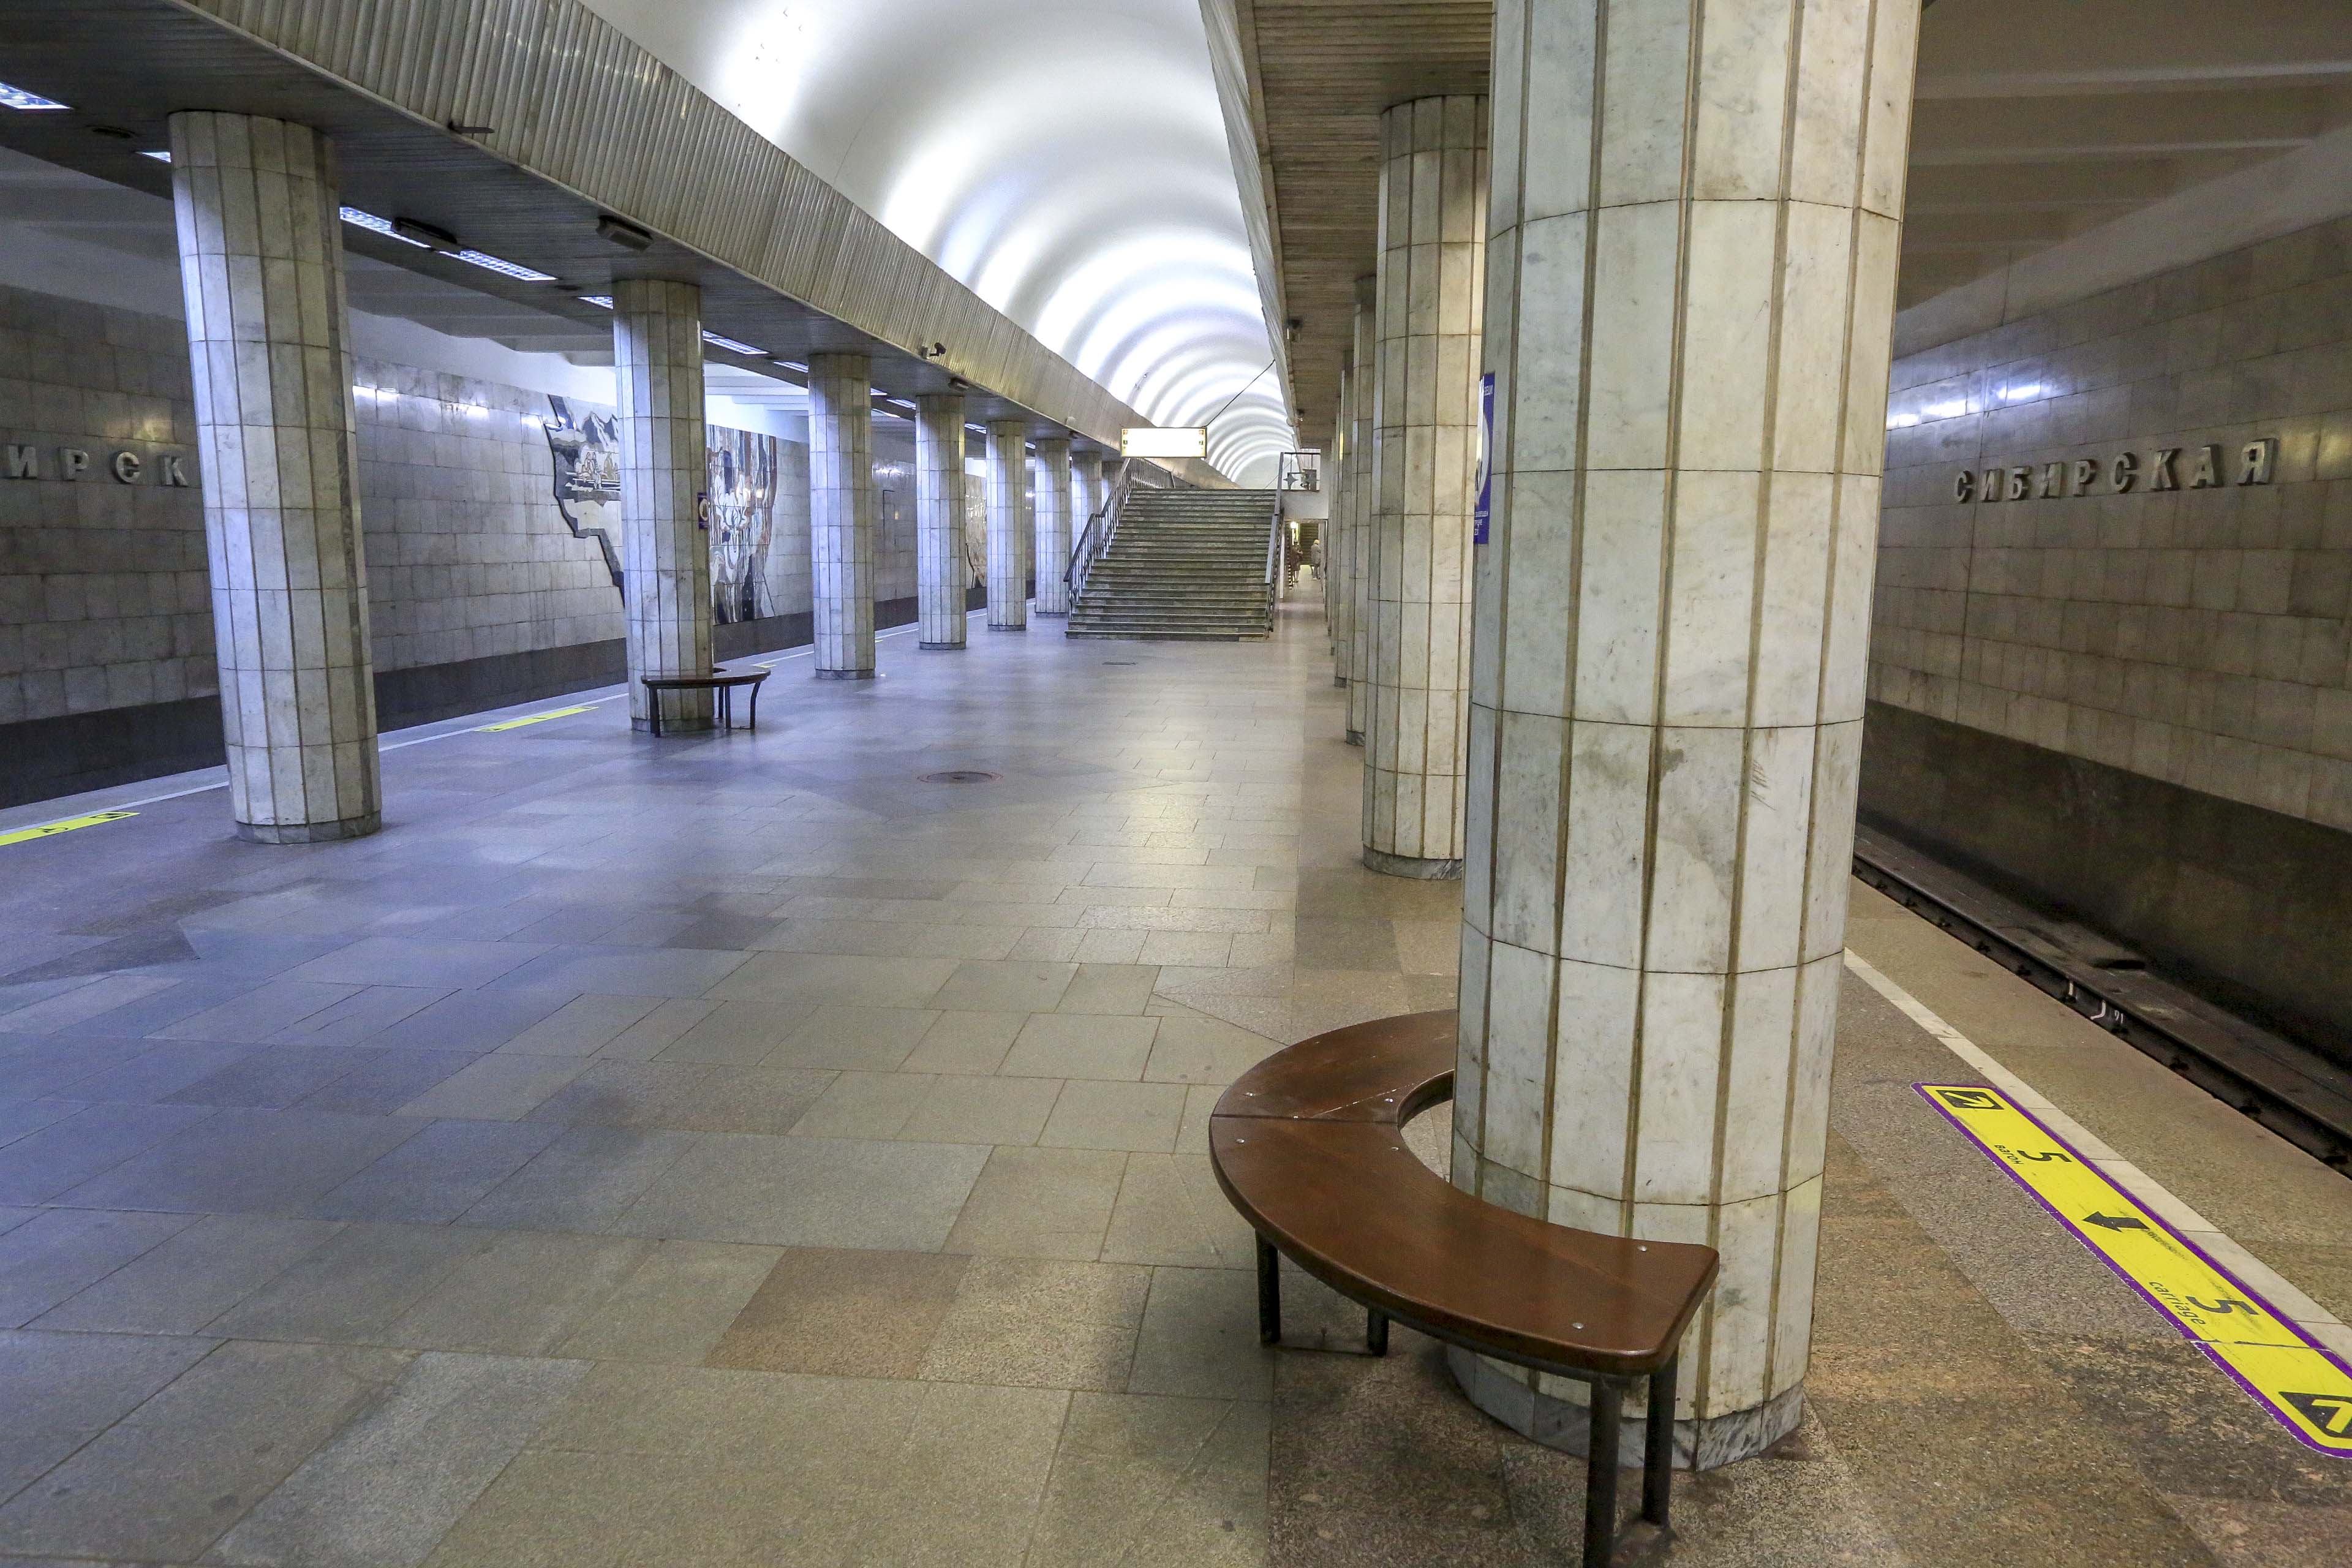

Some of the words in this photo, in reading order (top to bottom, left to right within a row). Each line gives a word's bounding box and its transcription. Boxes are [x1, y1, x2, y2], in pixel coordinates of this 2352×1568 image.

[1954, 437, 2278, 503] СИБИРСКАЯ
[1994, 1144, 2024, 1164] вагон
[2016, 1150, 2073, 1163] 5
[2148, 1281, 2207, 1325] carriage
[2185, 1295, 2260, 1315] 5
